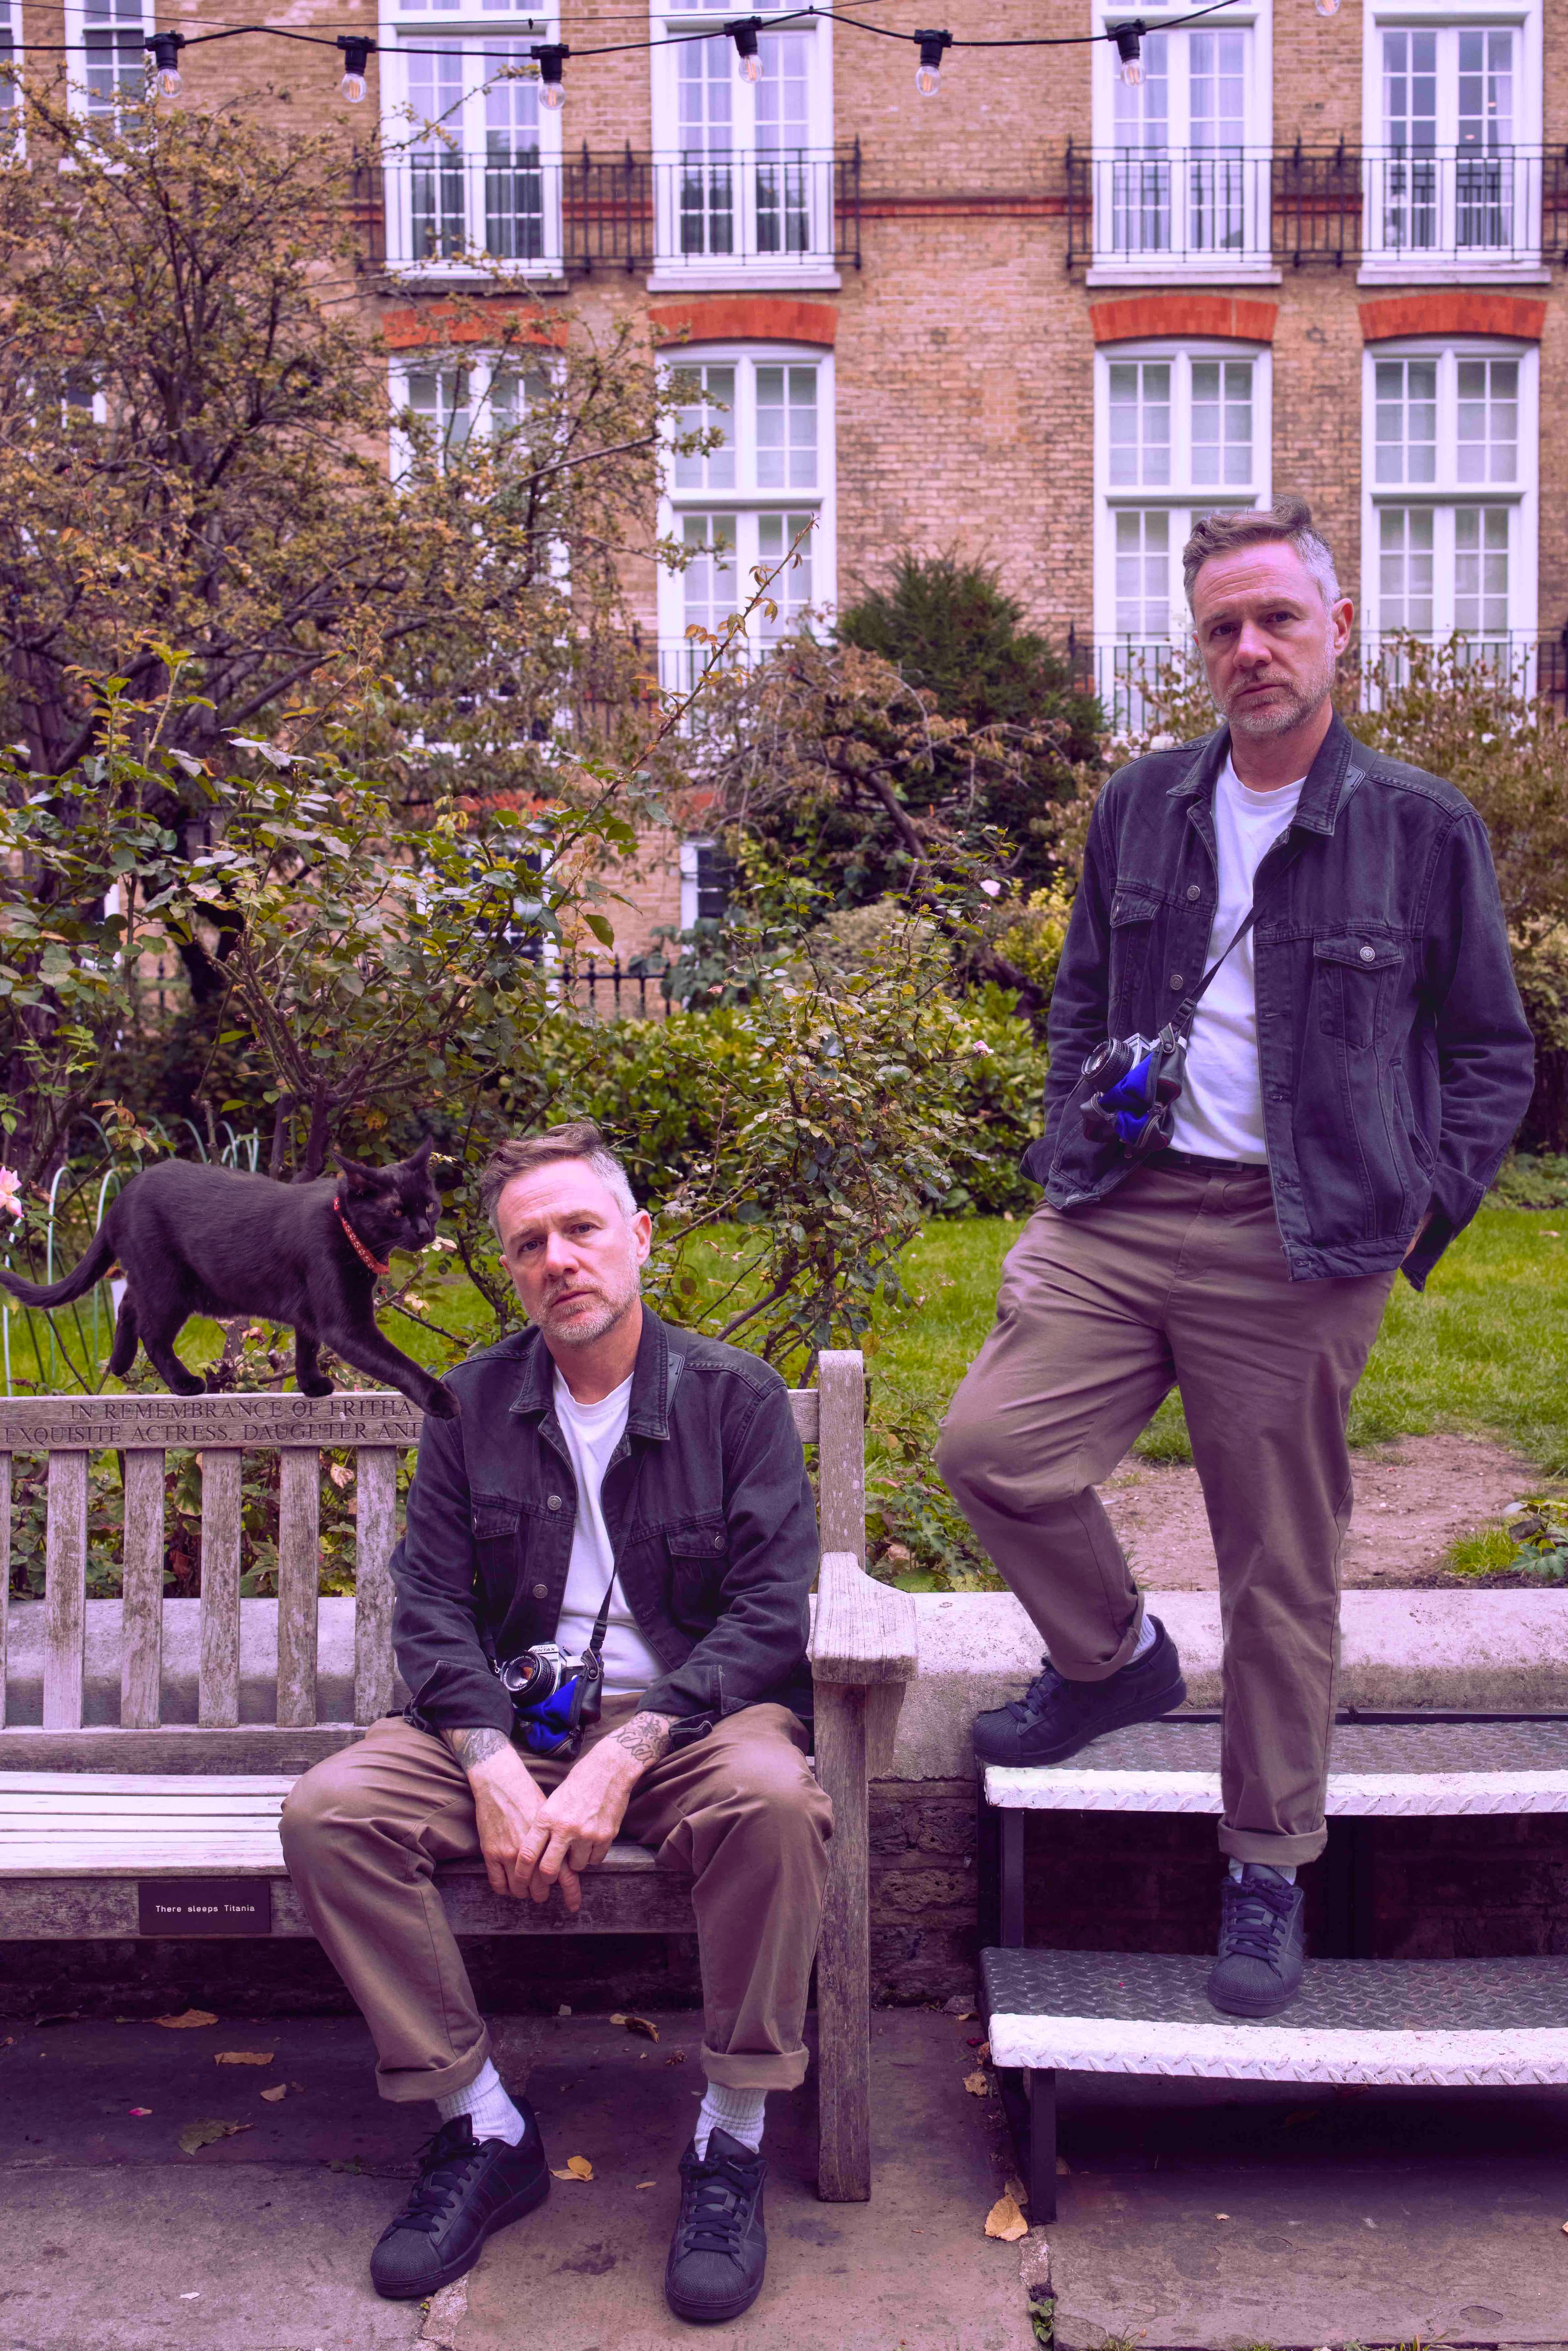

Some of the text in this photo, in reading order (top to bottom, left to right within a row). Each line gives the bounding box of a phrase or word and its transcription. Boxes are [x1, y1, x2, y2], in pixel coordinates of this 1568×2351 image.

[71, 1400, 413, 1420] IN REMEMBRANCE OF FRITHA
[6, 1426, 121, 1446] EXQUISITE
[243, 1423, 369, 1440] DAUGHTER
[187, 1905, 218, 1913] sleeps
